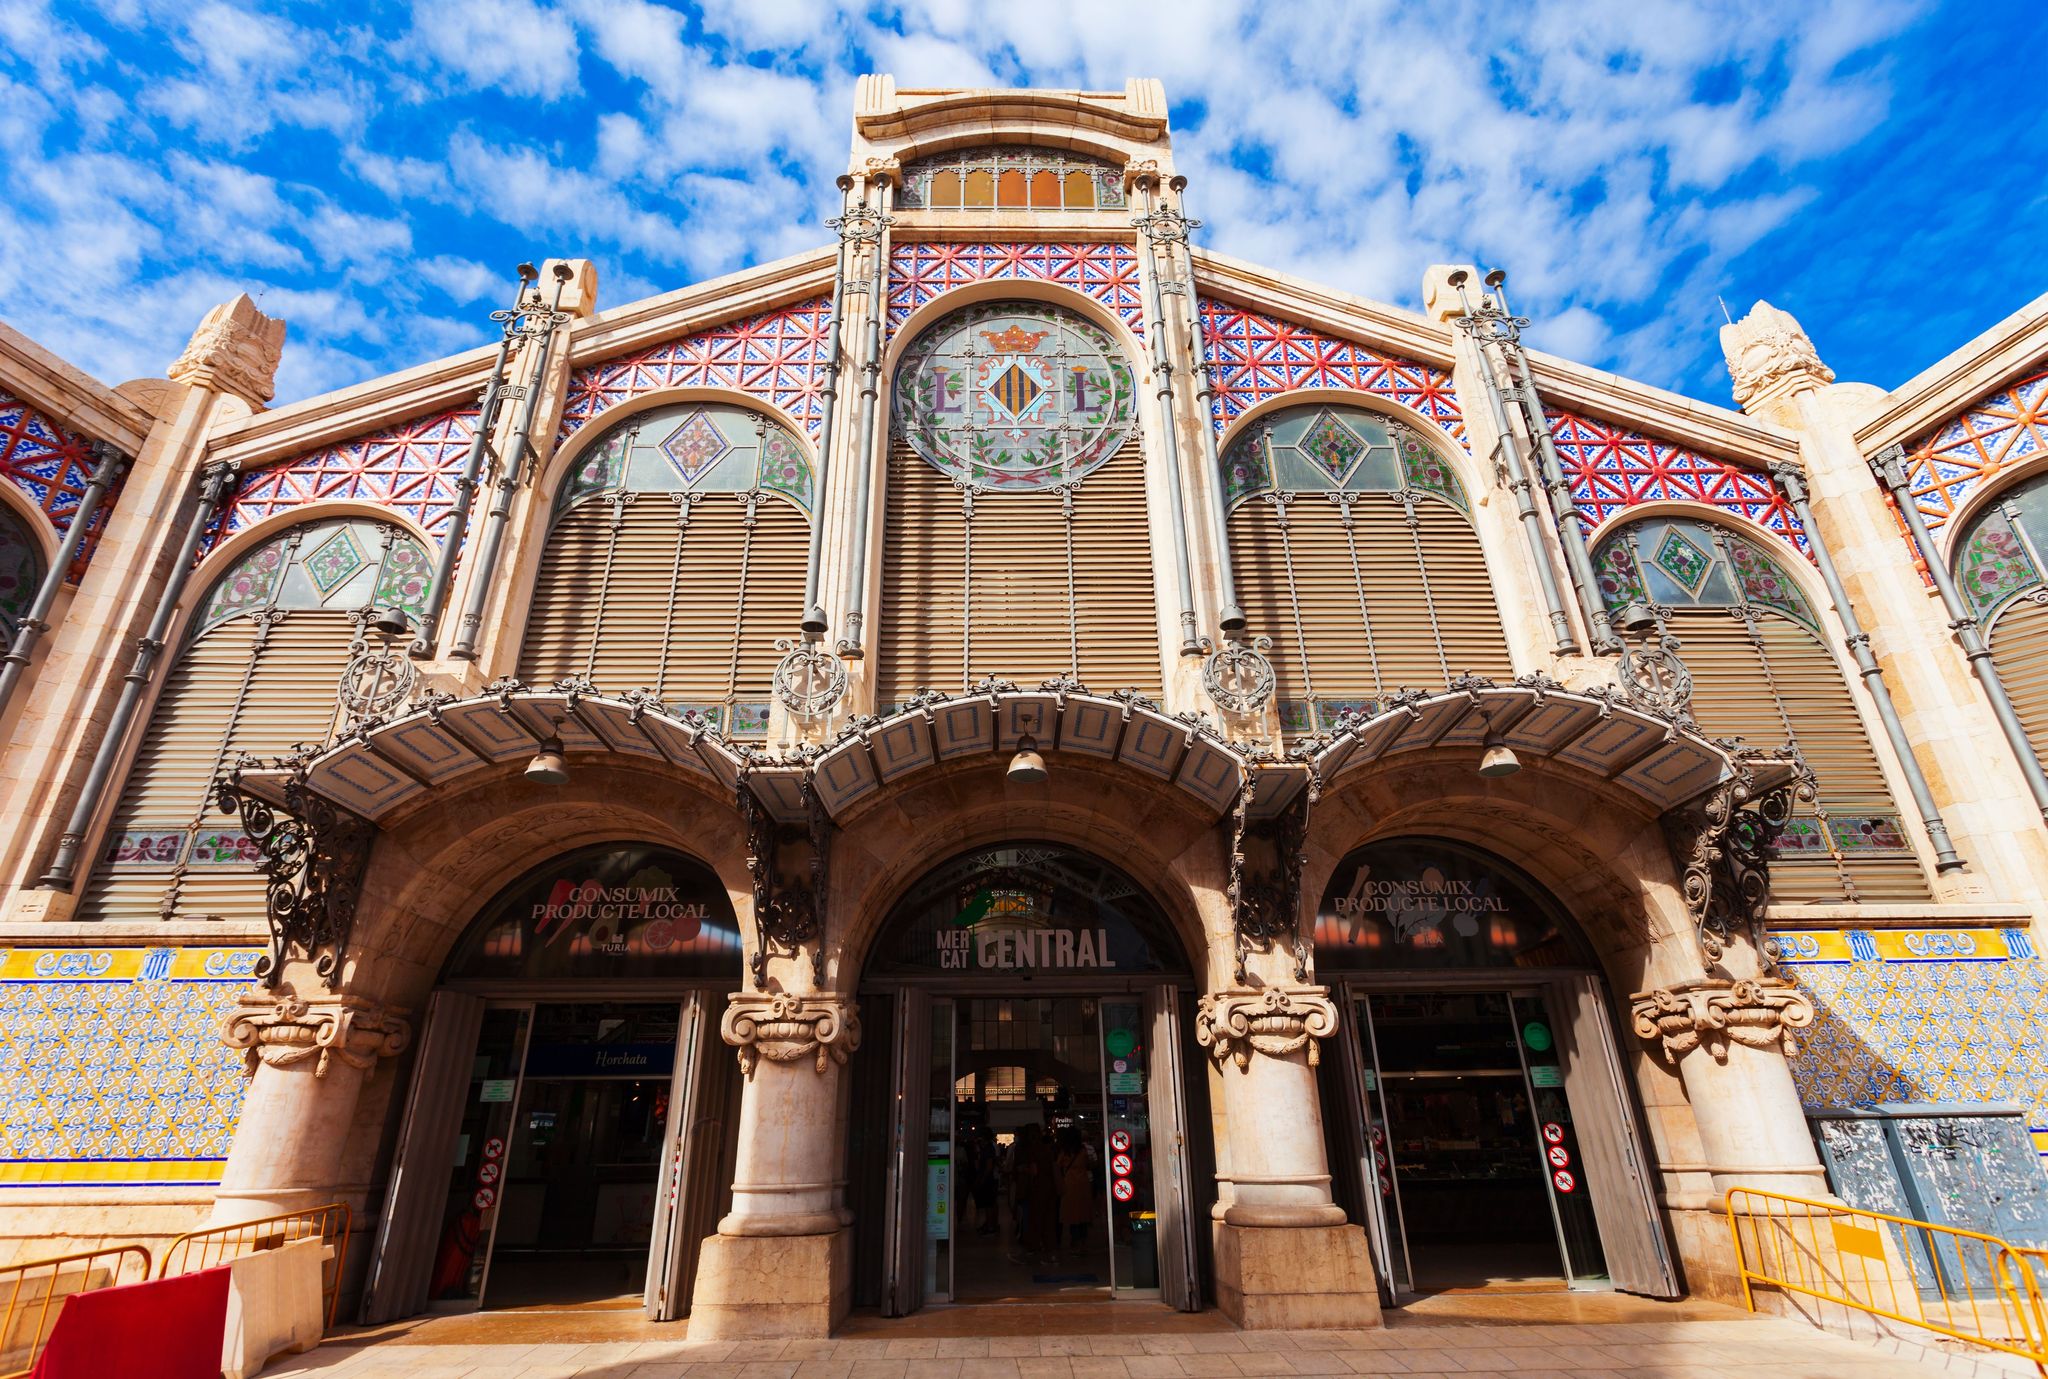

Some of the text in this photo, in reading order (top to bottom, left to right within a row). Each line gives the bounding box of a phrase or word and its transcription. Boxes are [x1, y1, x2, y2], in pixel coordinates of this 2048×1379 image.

[569, 887, 680, 902] CONSUMIX
[1365, 880, 1473, 895] CONSUMIX
[531, 903, 710, 919] PRODUCTE LOCAL
[1334, 897, 1509, 912] PRODUCTE LOCAL
[601, 943, 631, 952] TURIA
[936, 930, 970, 949] MER
[976, 928, 1116, 968] CENTRAL
[940, 950, 970, 969] CAT
[595, 1051, 648, 1067] Horchata
